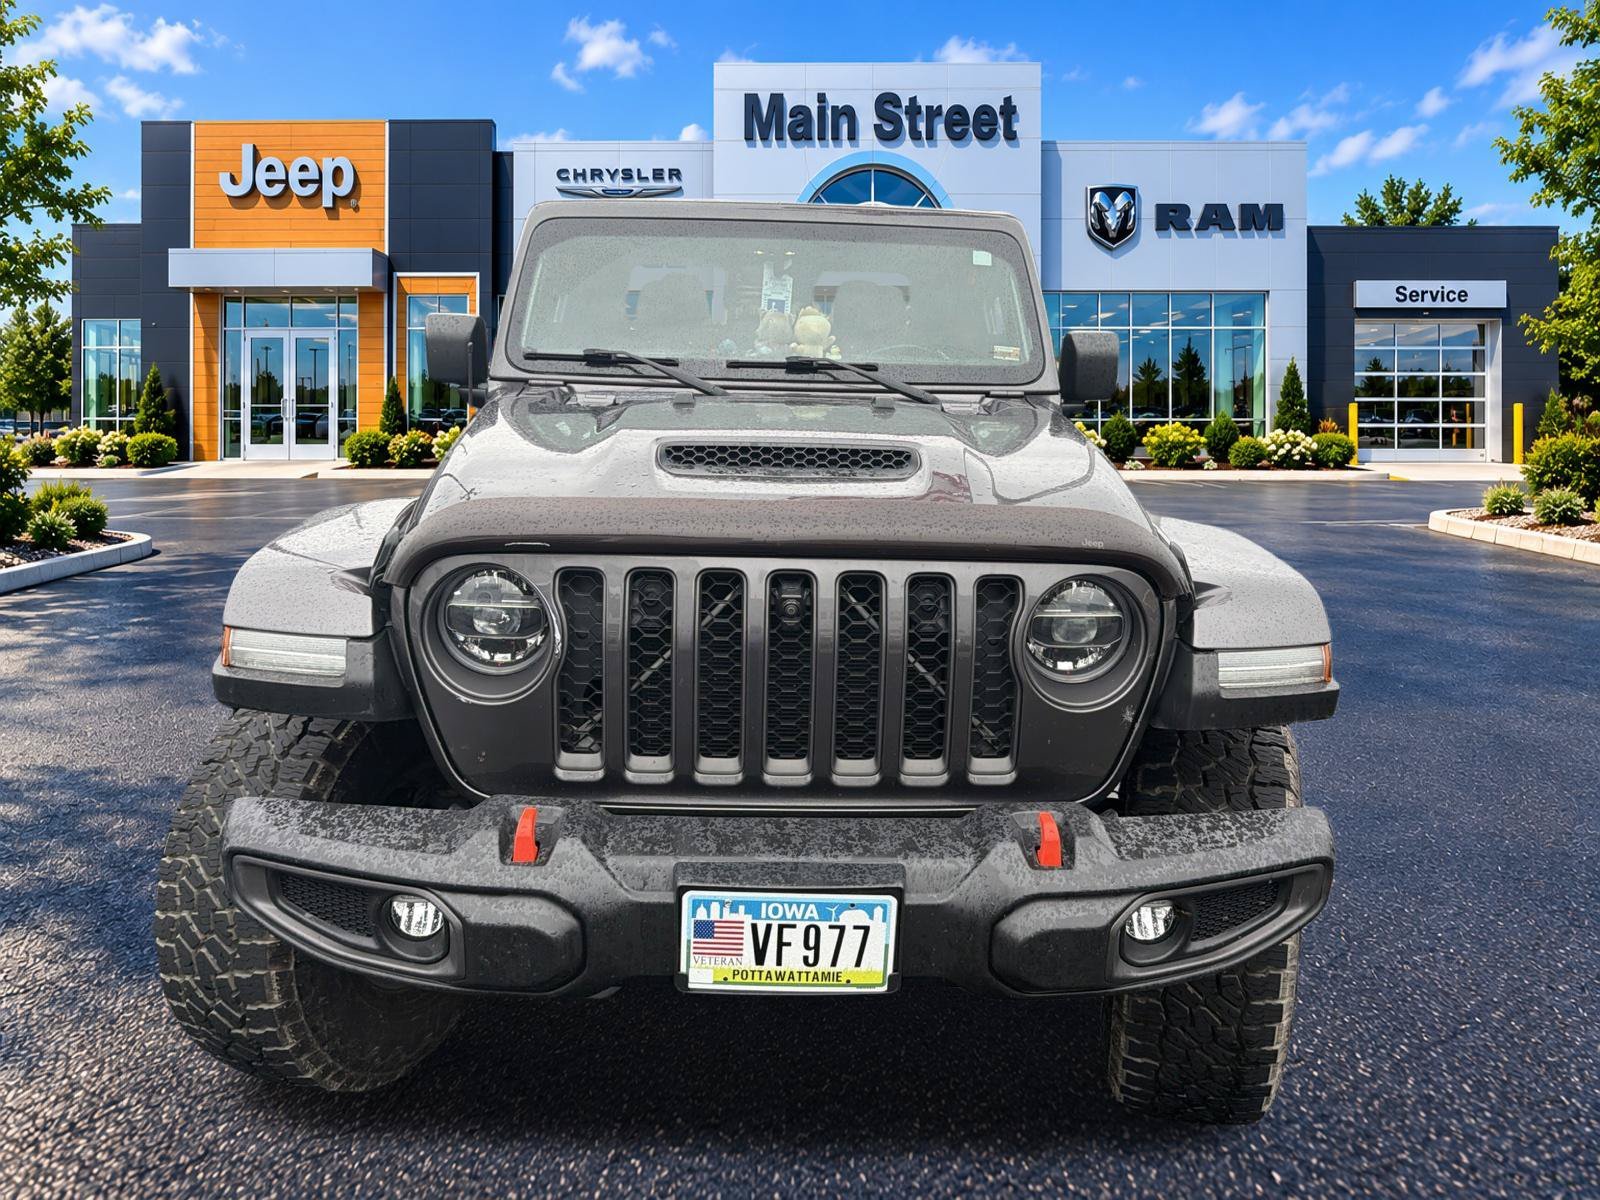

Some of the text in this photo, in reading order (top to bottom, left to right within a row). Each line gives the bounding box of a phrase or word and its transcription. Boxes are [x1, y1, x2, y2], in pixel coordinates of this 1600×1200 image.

[743, 91, 1018, 141] Main Street
[218, 143, 355, 208] Jeep
[556, 168, 683, 182] CHRYSLER
[1155, 203, 1284, 231] RAM
[1395, 285, 1469, 303] Service
[1081, 538, 1105, 550] Jeep
[760, 902, 820, 920] IOWA
[750, 922, 871, 968] VF977
[692, 955, 743, 967] VETERAN
[732, 969, 843, 983] POTTAWATTAMIE
